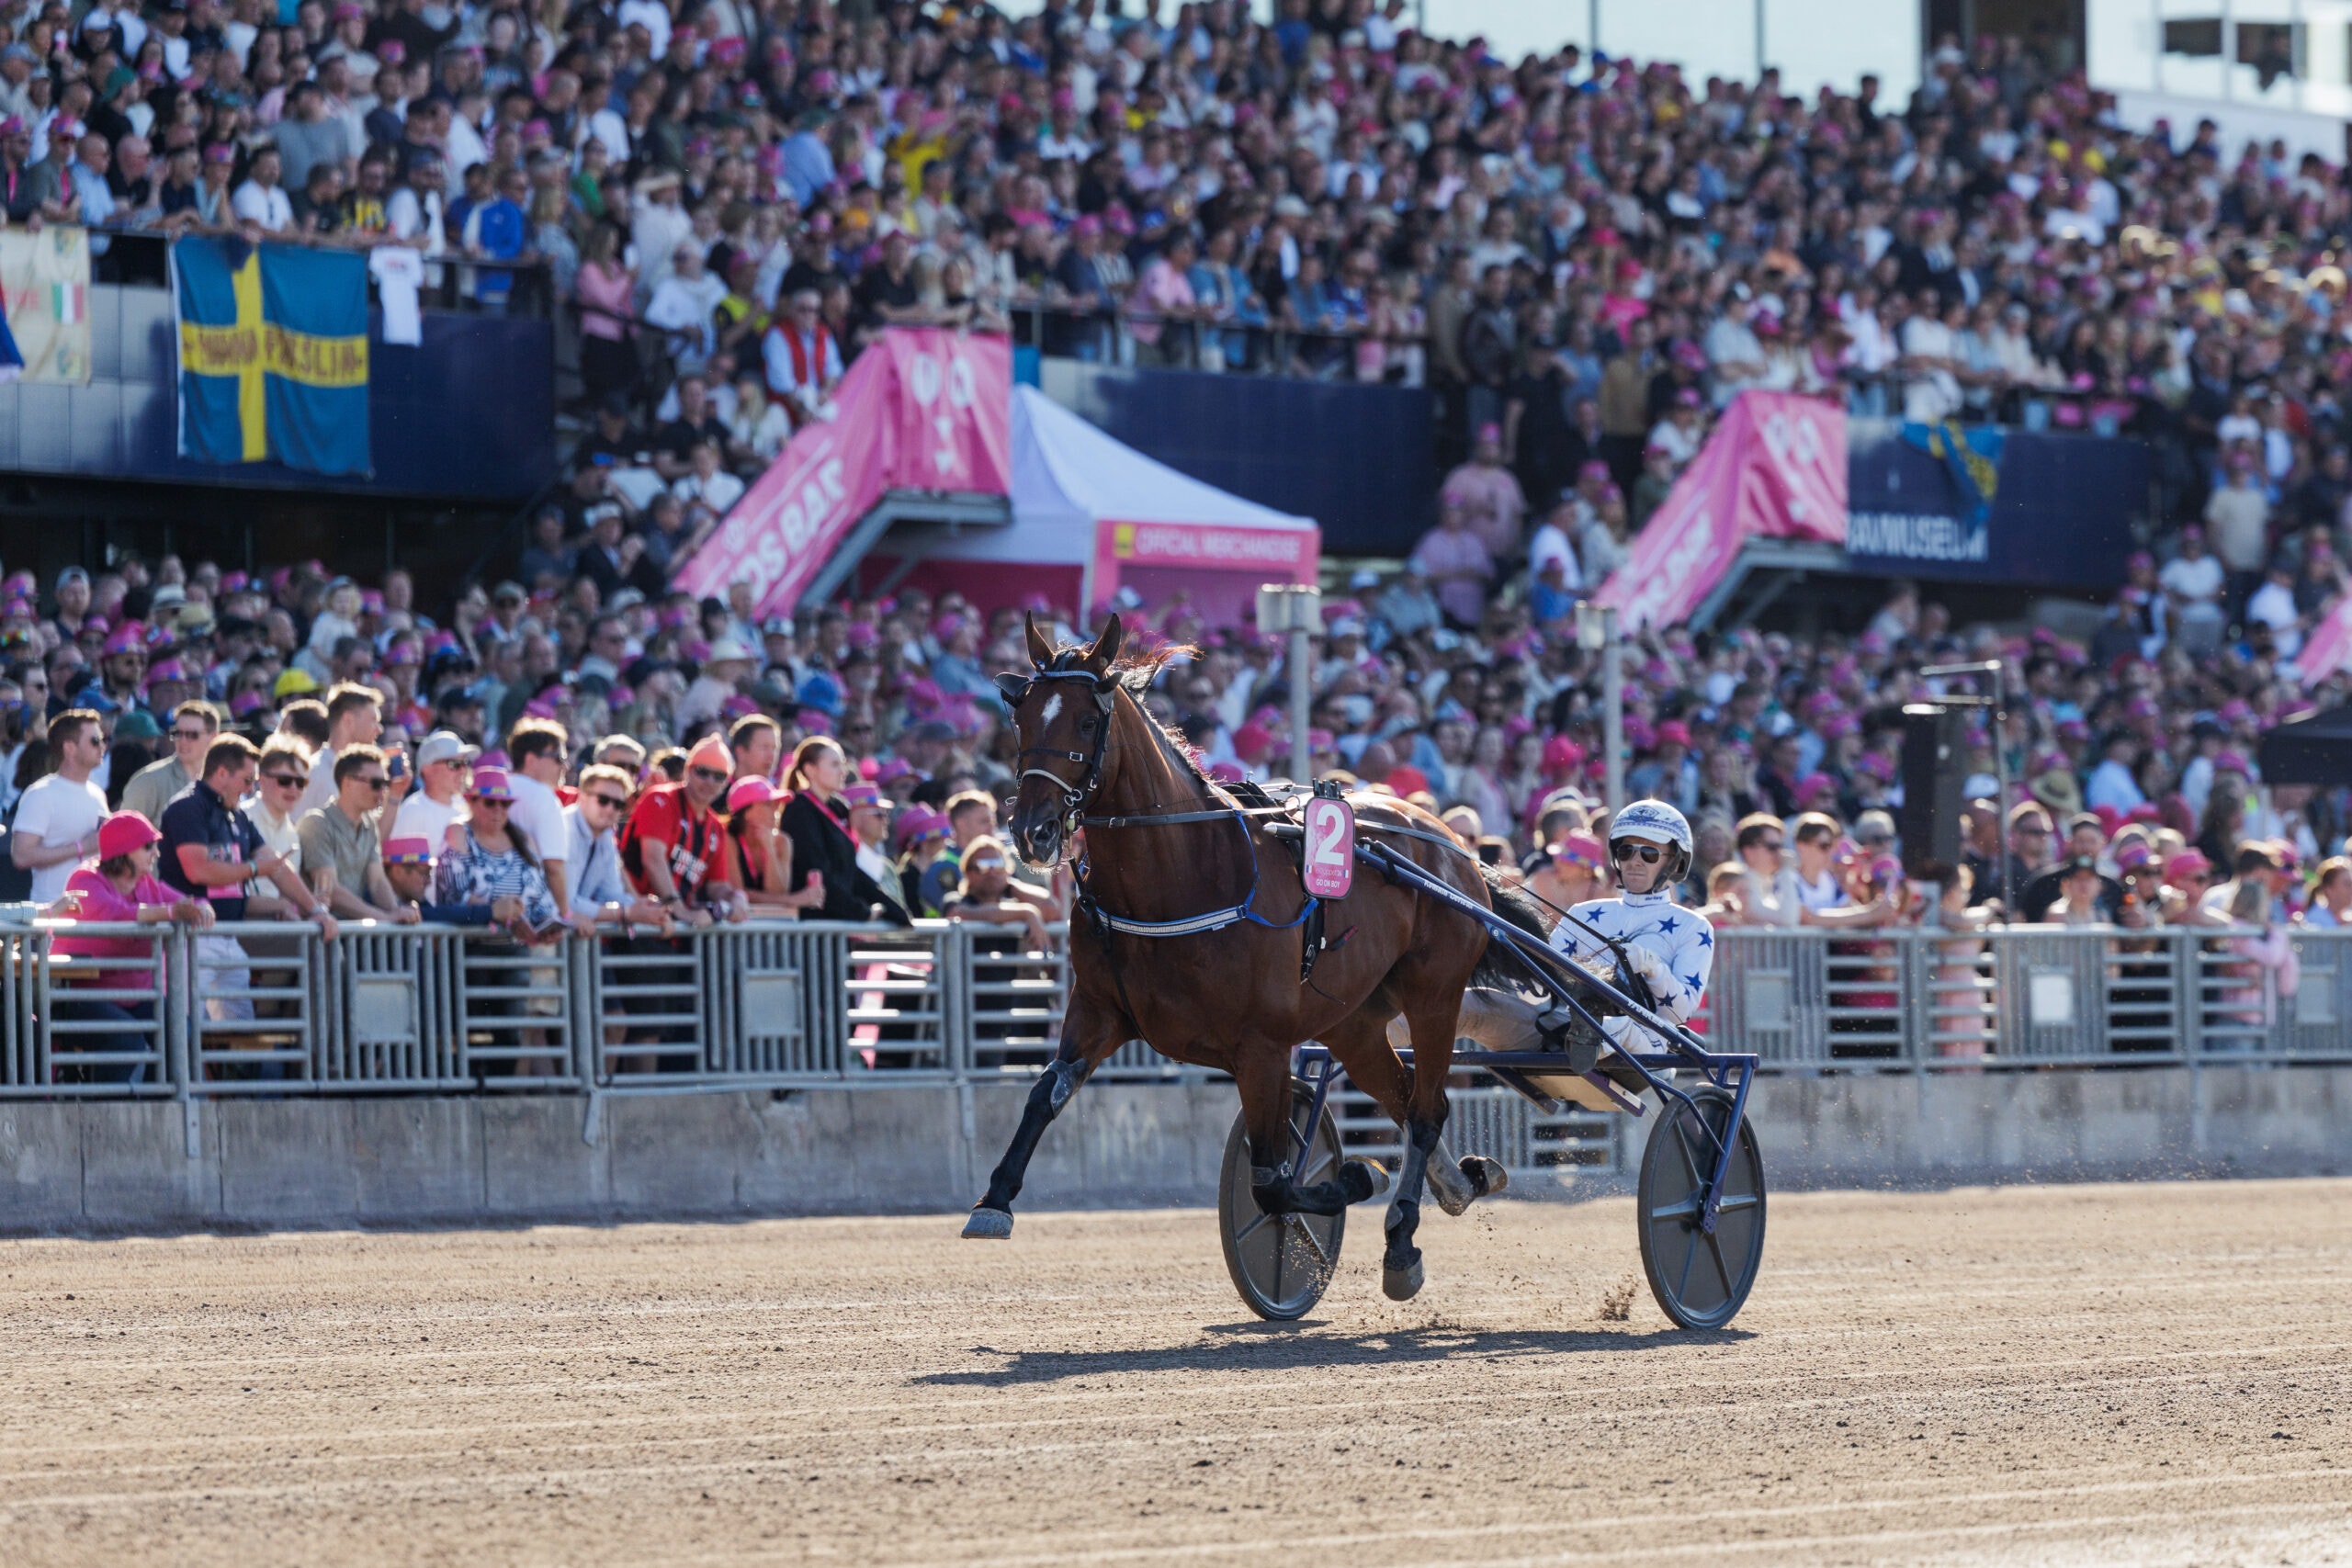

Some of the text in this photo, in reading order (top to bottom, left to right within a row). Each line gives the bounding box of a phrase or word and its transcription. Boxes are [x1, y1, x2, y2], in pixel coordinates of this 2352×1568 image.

[1316, 805, 1345, 865] 2
[1316, 878, 1340, 888] GO ON BOY
